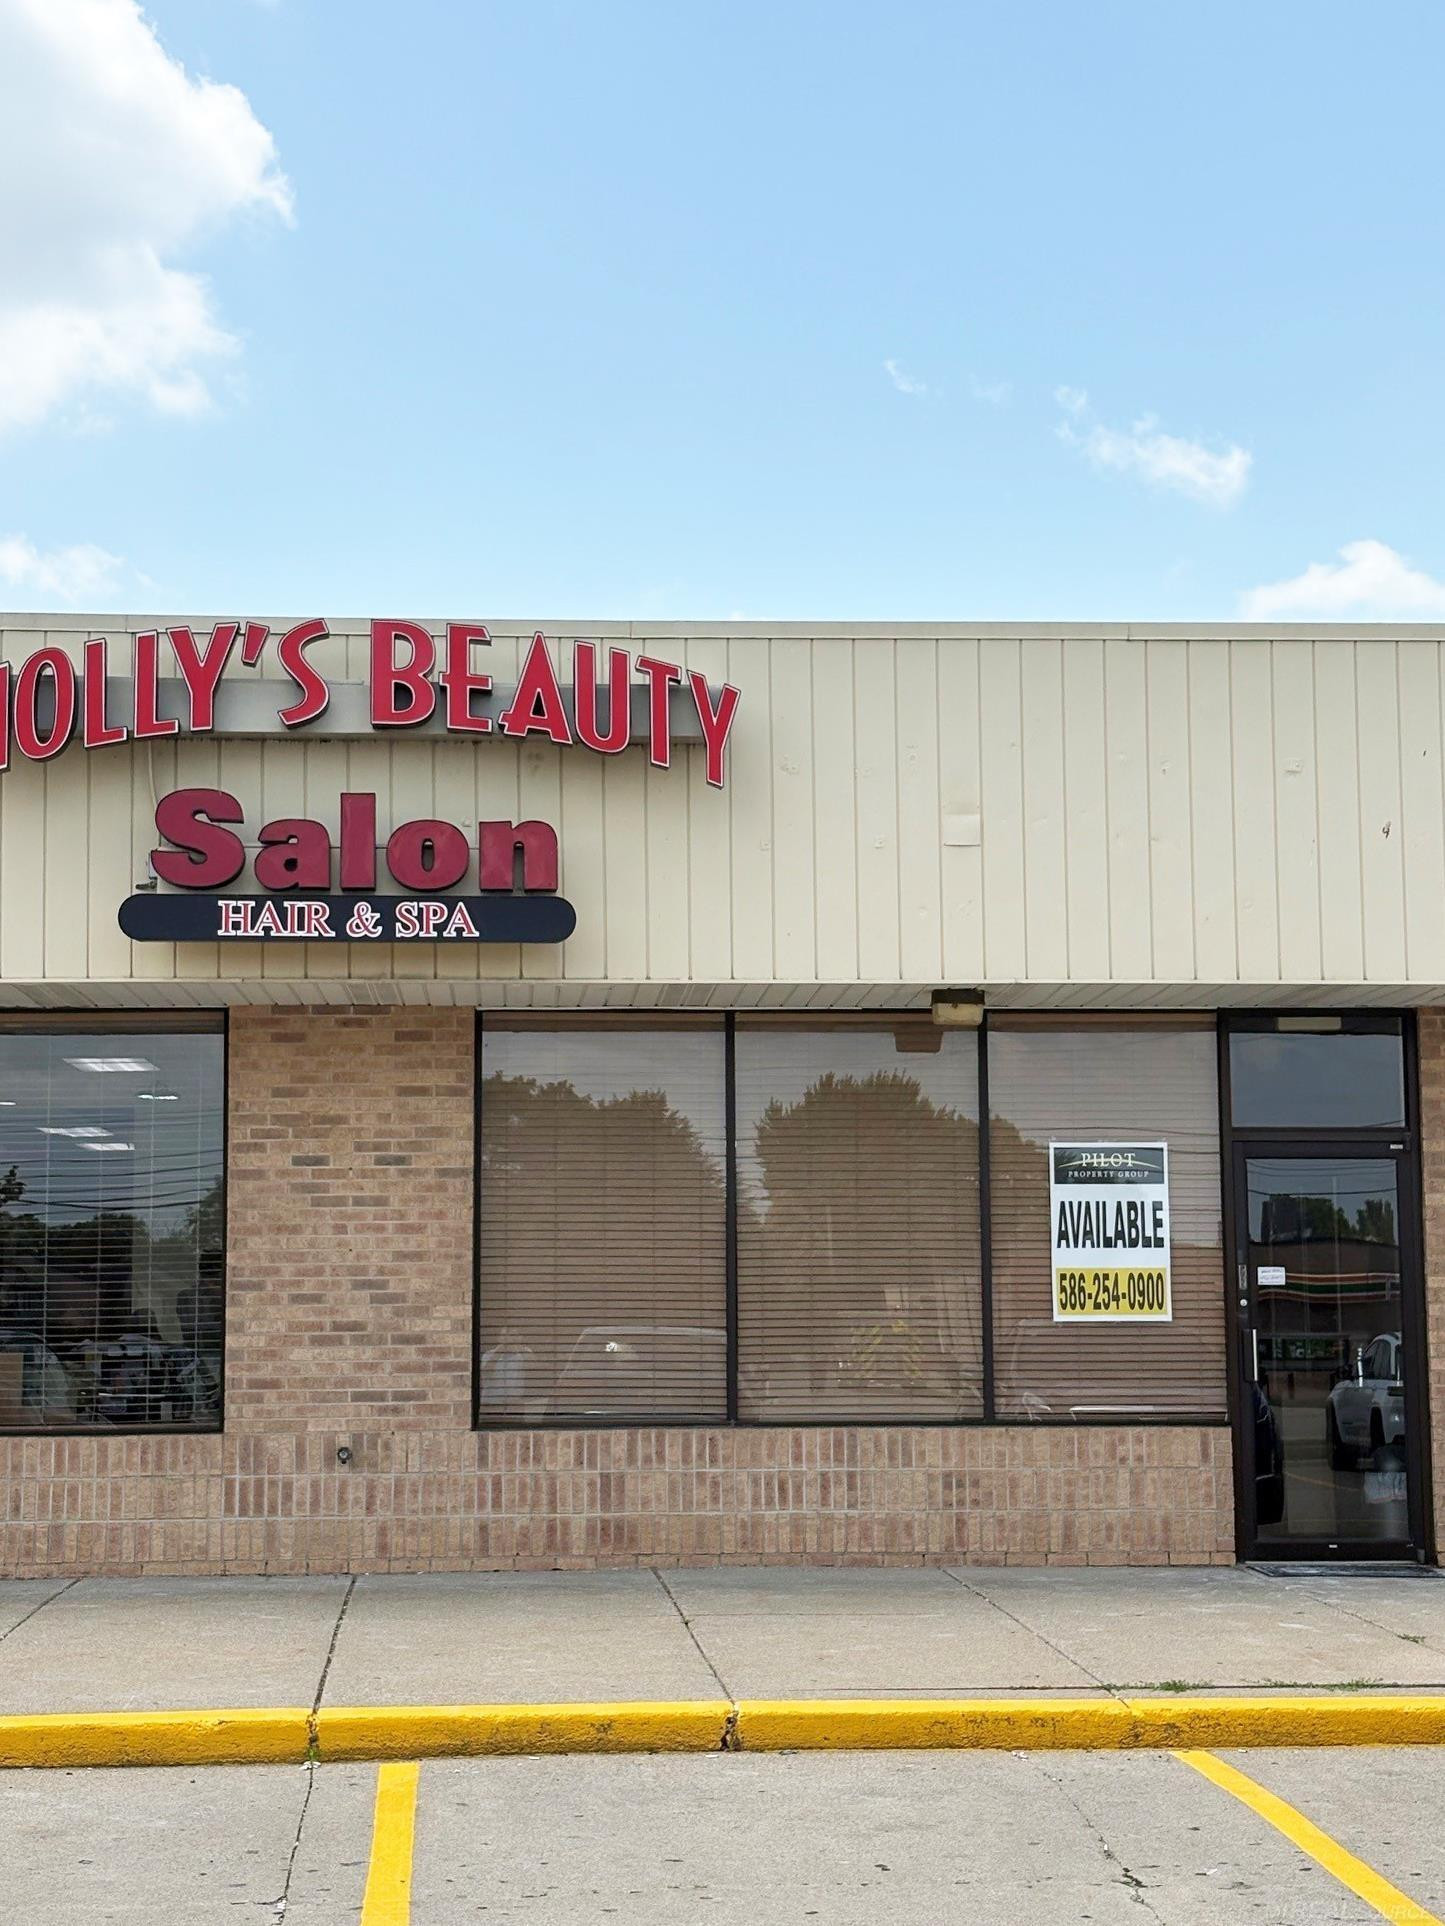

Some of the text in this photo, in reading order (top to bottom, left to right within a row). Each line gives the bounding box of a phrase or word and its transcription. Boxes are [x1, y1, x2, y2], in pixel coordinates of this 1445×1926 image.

[370, 618, 742, 789] BEAUTY
[150, 788, 559, 892] Salon
[217, 900, 480, 939] HAIR & SPA
[1067, 1170, 1150, 1178] PROPERTY GROUP
[1081, 1152, 1136, 1167] PILOT
[1057, 1200, 1165, 1249] AVAILABLE
[1059, 1271, 1165, 1311] 586-254-0900
